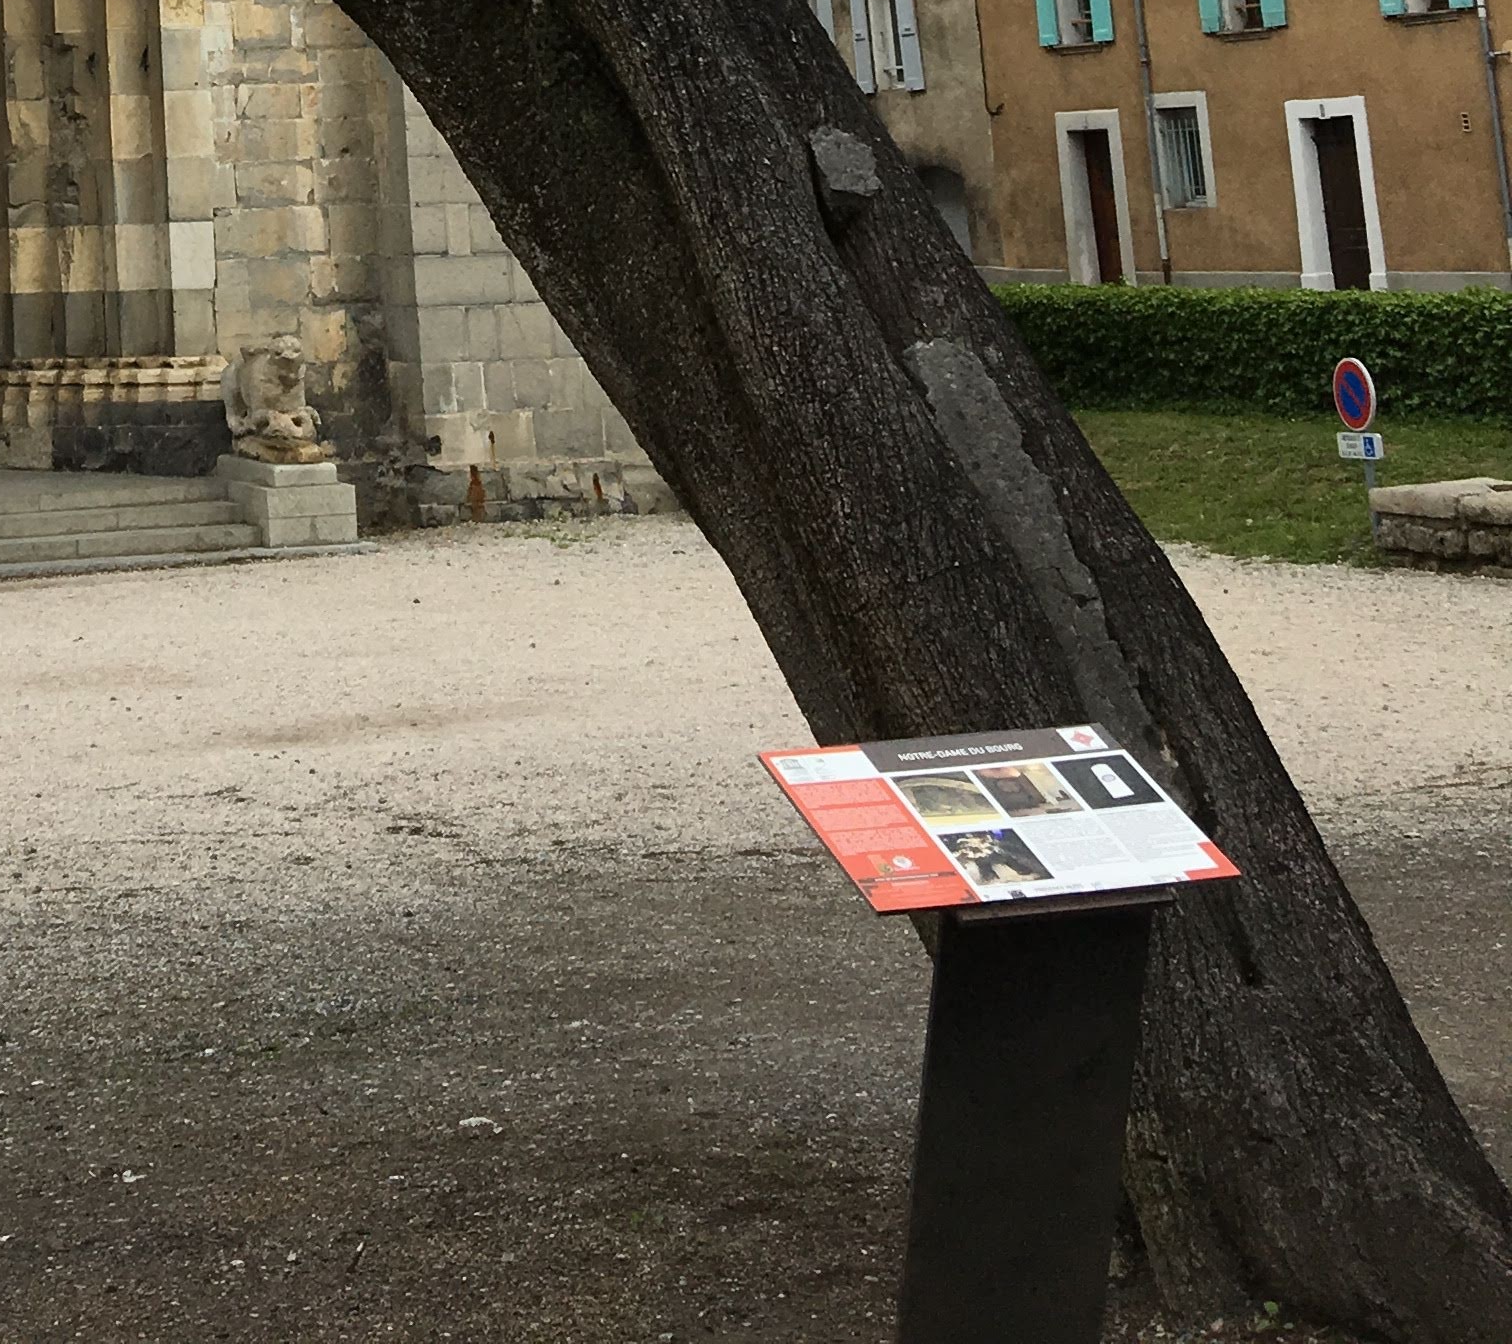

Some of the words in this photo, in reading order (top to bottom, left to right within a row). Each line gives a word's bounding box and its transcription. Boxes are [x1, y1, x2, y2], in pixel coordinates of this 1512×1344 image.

[897, 748, 969, 761] NOTRE-DAME
[968, 746, 986, 755] DU
[985, 742, 1024, 754] BOURG
